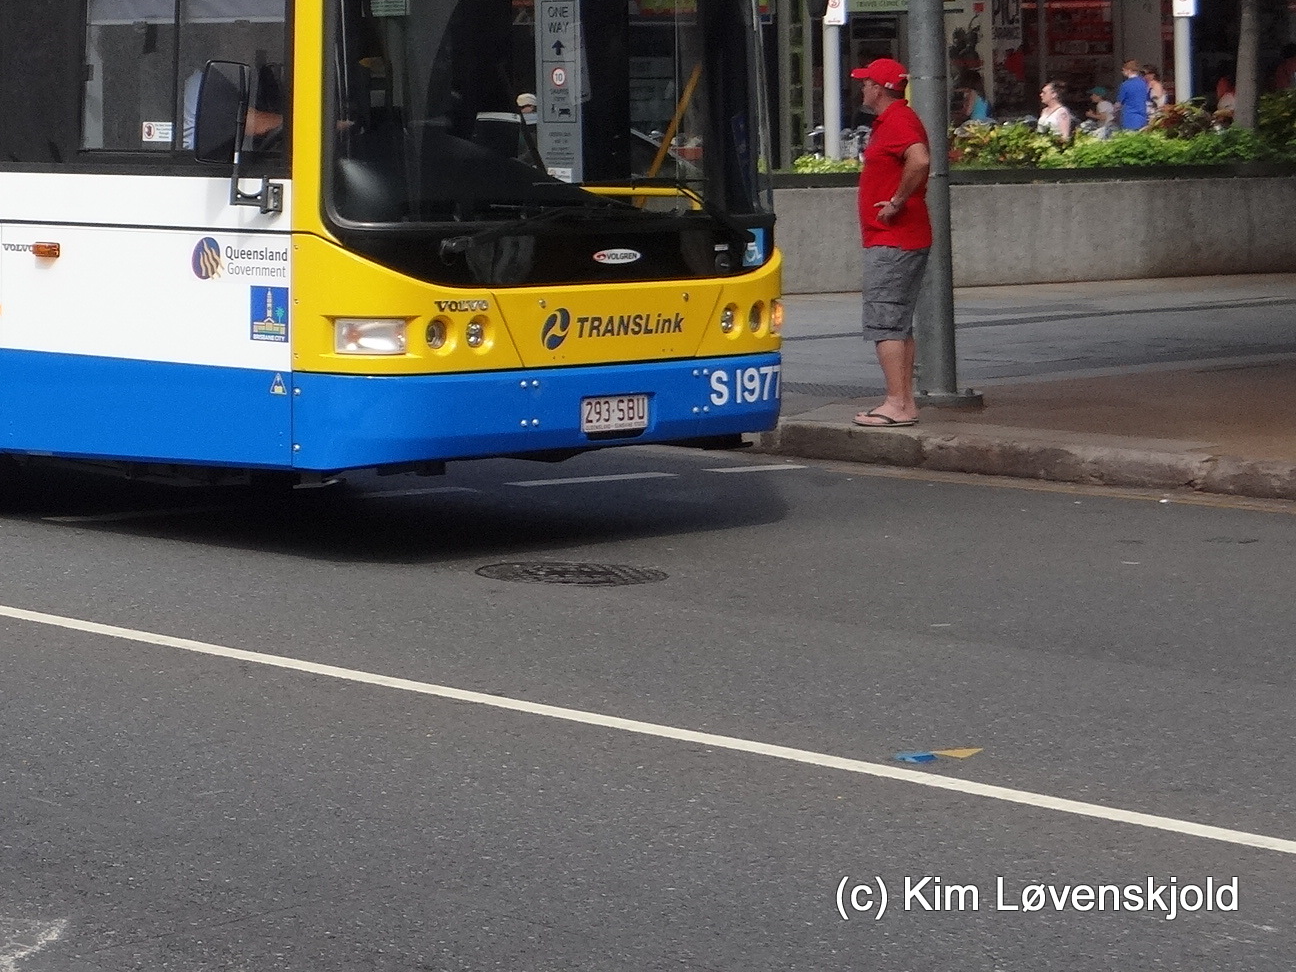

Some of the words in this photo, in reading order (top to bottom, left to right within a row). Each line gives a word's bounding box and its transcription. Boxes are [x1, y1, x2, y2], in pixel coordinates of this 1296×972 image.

[547, 6, 569, 19] ONE
[547, 22, 569, 34] WAY
[554, 73, 563, 83] 10
[225, 245, 288, 261] Queensland
[227, 262, 286, 278] Government
[434, 300, 488, 312] VOLVO
[577, 312, 684, 338] TRANSLink
[710, 370, 729, 406] S
